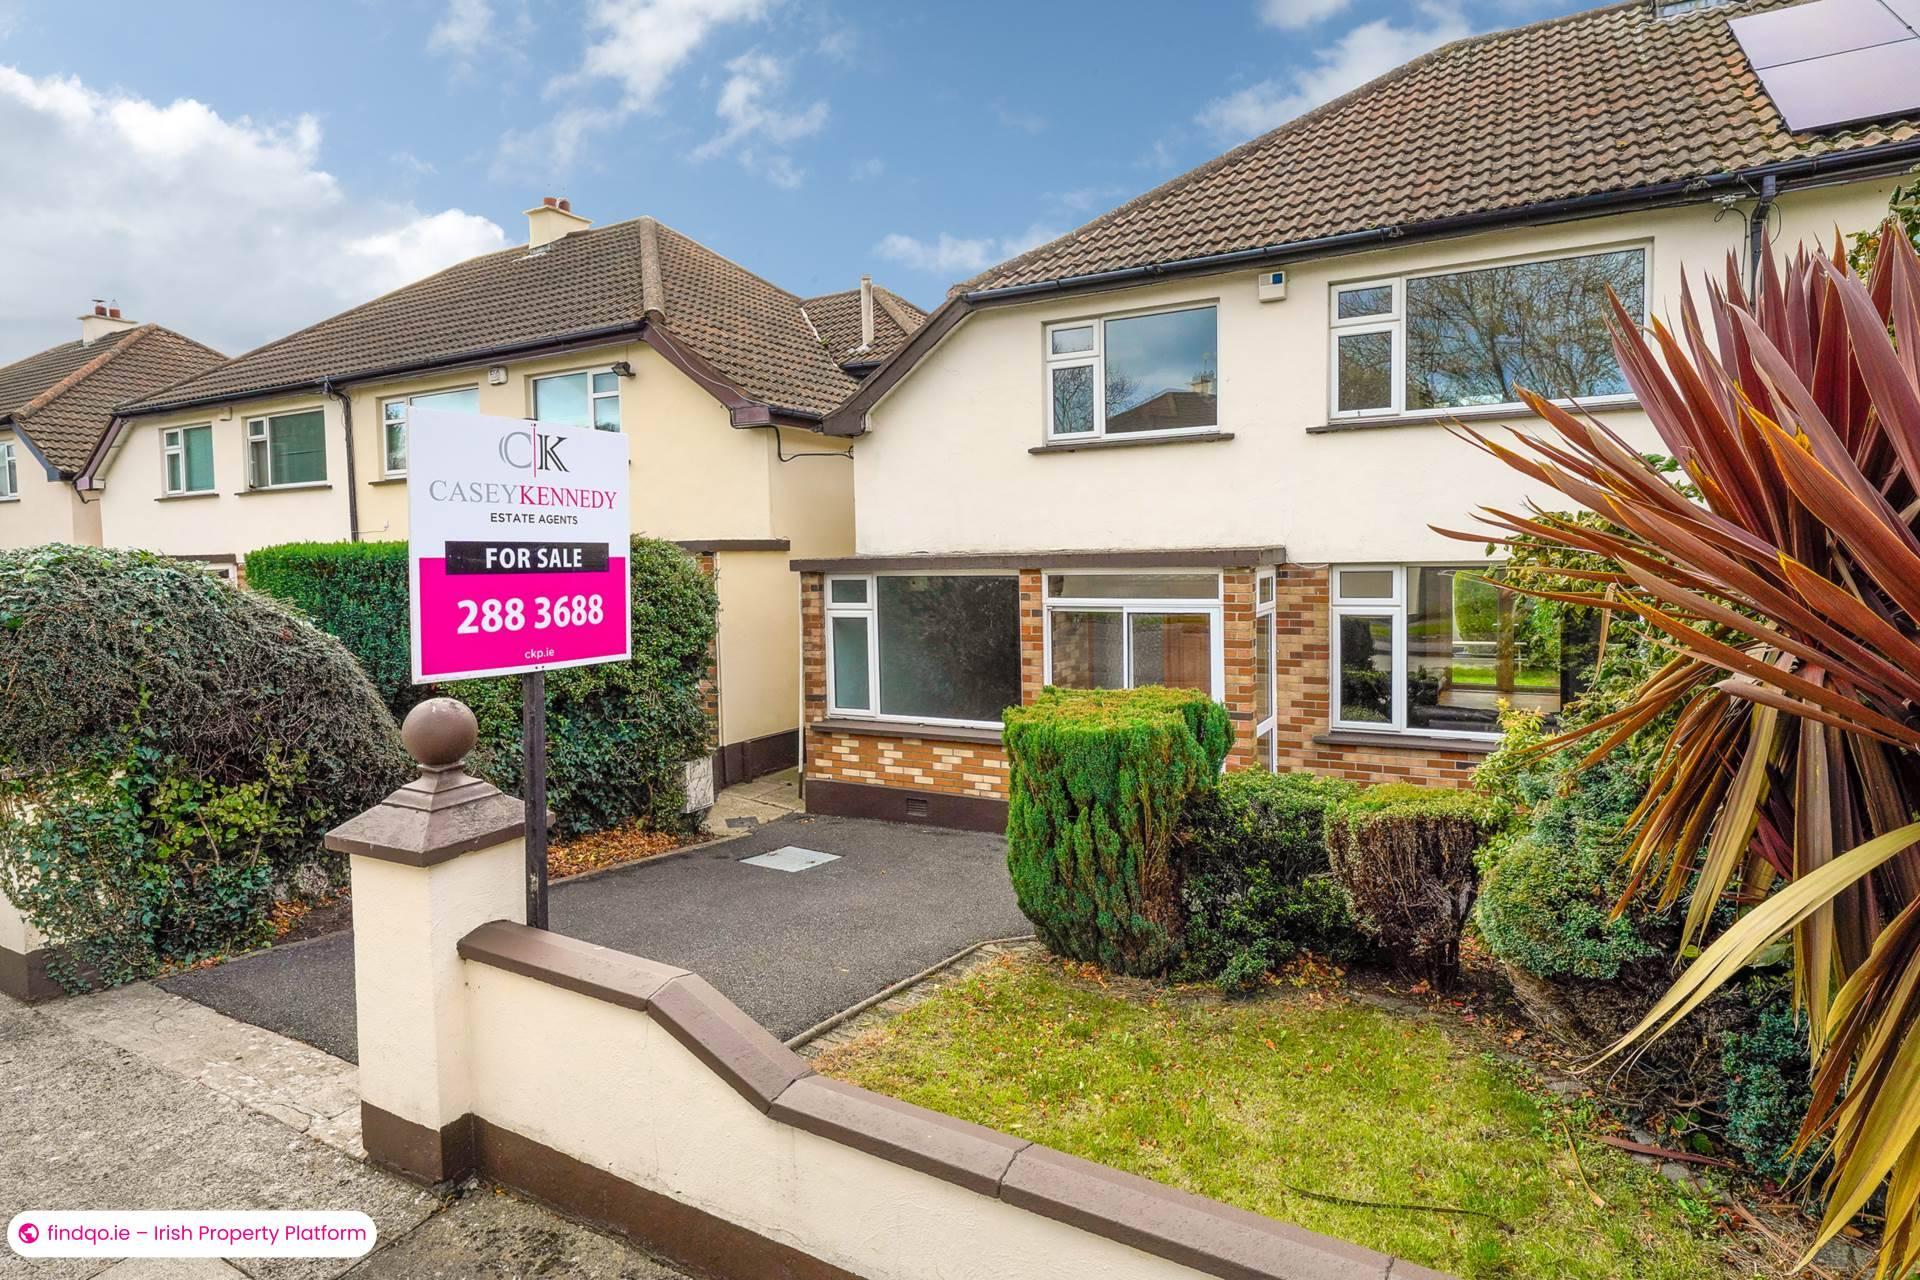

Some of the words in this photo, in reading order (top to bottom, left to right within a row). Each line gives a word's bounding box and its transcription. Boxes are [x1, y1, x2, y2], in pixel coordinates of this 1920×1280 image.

[490, 512, 535, 524] ESTATE
[538, 514, 578, 525] AGENTS
[485, 548, 531, 568] FOR
[538, 547, 583, 568] SALE
[457, 597, 525, 635] 288
[534, 594, 604, 629] 3688
[524, 647, 555, 660] ckp.ie
